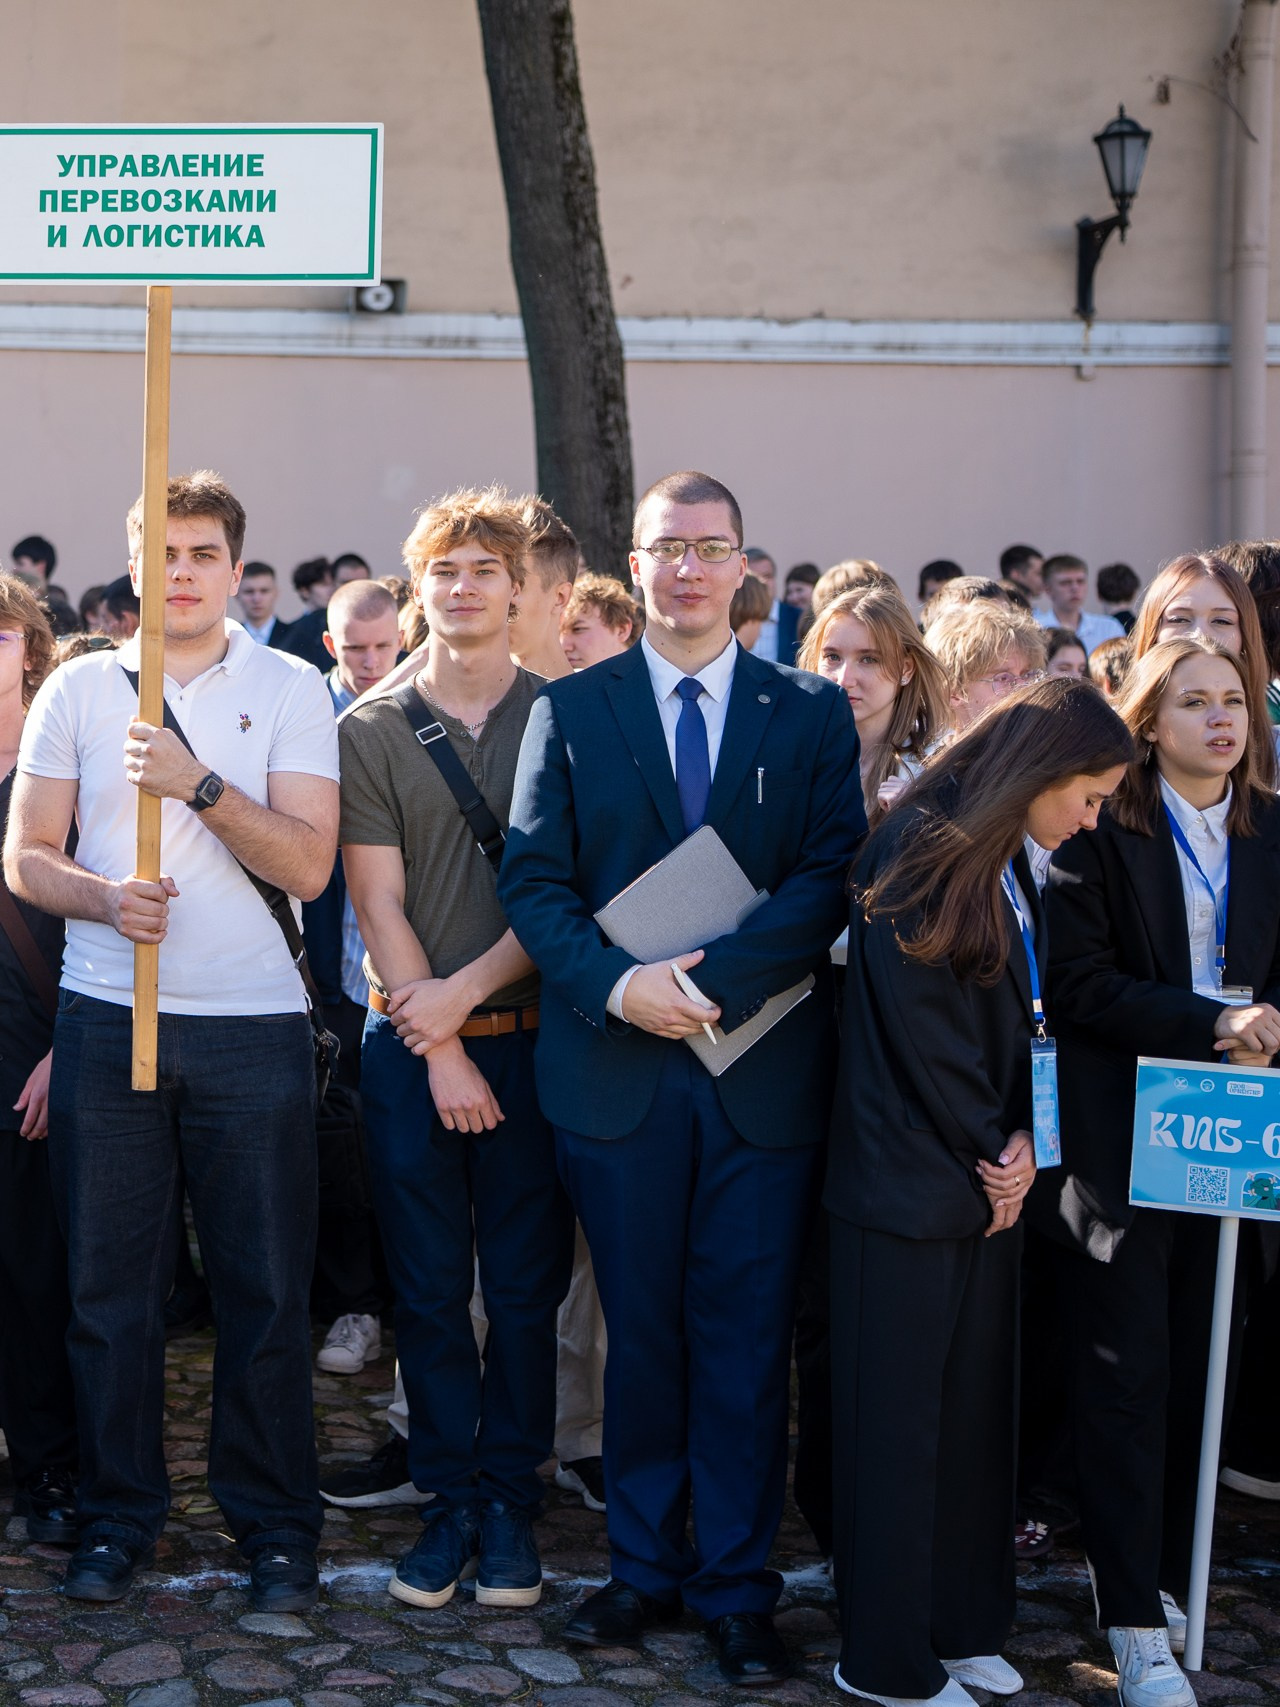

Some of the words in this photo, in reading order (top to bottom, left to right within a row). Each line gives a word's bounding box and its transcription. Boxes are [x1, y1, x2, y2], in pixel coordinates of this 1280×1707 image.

[56, 153, 265, 178] УПРАВЛЕНИЕ
[38, 188, 277, 213] ПЕРЕВОЗКАМИ
[46, 224, 67, 248] И
[82, 223, 266, 248] ЛОГИСТИКА
